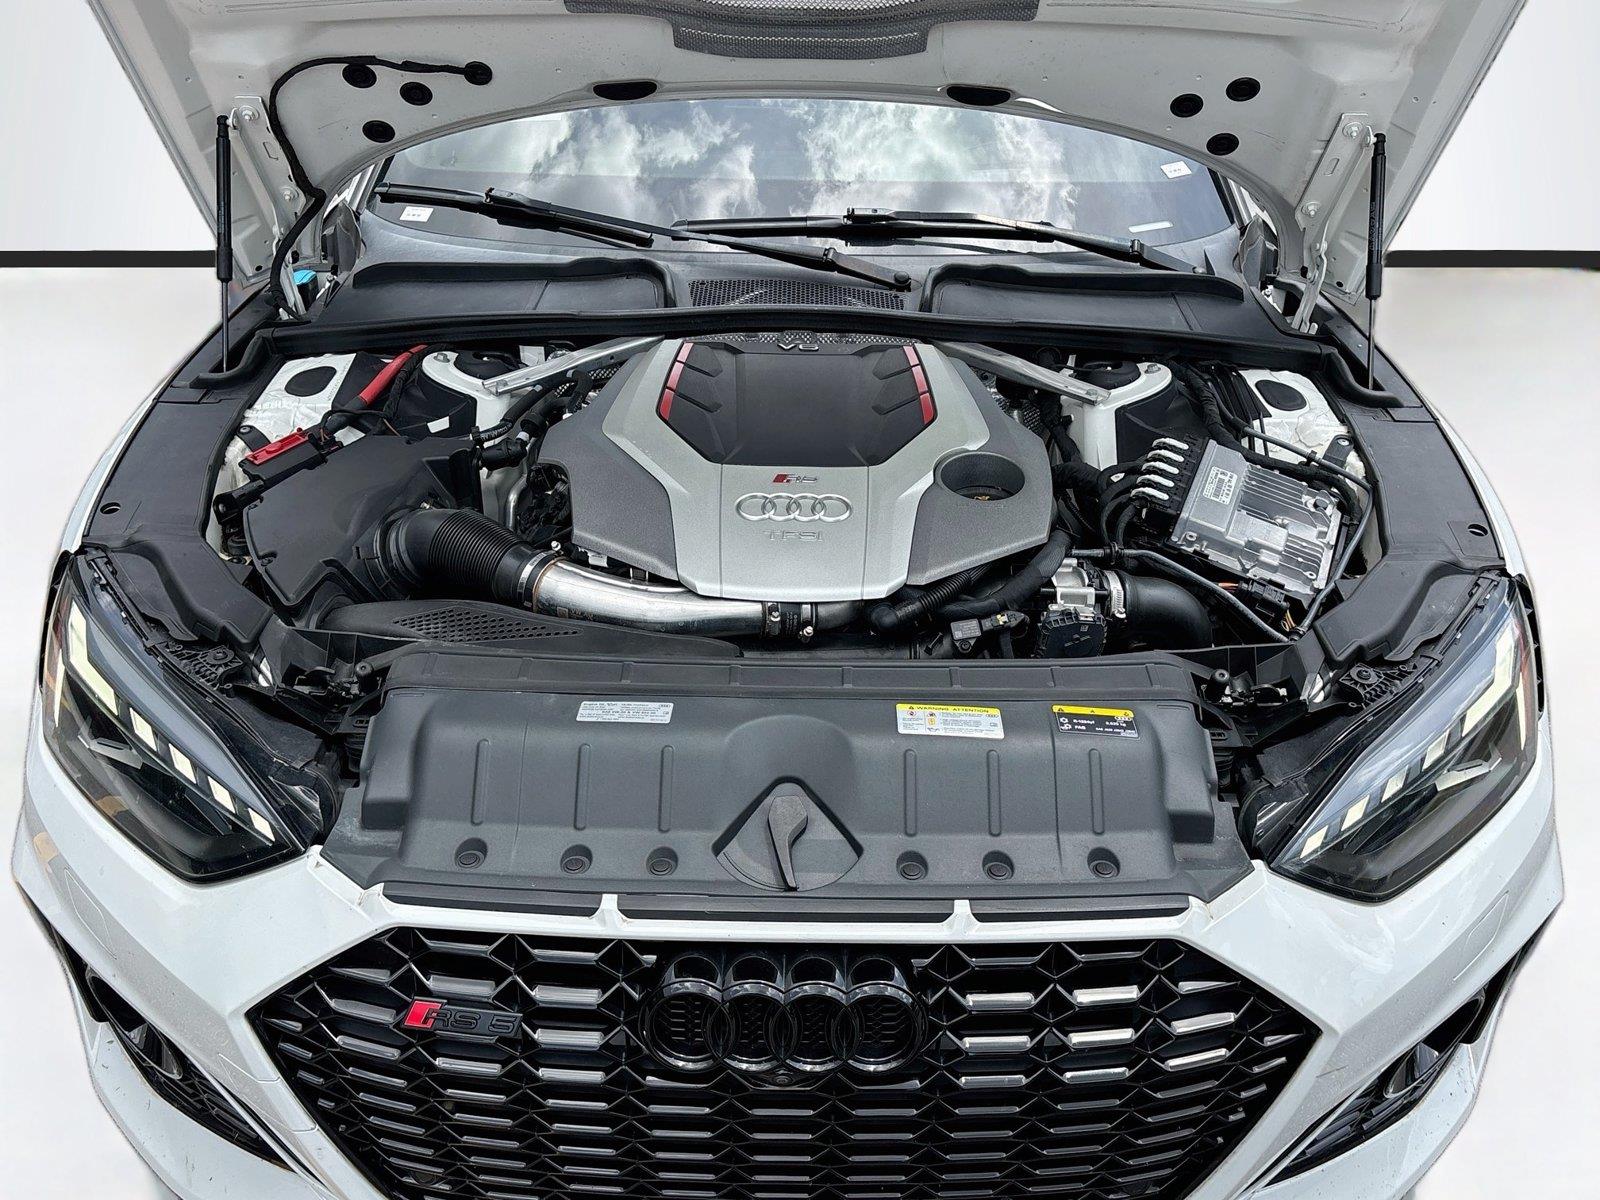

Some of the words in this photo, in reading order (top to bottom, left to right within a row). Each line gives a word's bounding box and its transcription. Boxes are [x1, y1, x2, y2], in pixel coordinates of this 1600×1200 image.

[763, 530, 823, 541] TFSI
[404, 1000, 481, 1030] RS
[488, 1013, 517, 1034] 5
